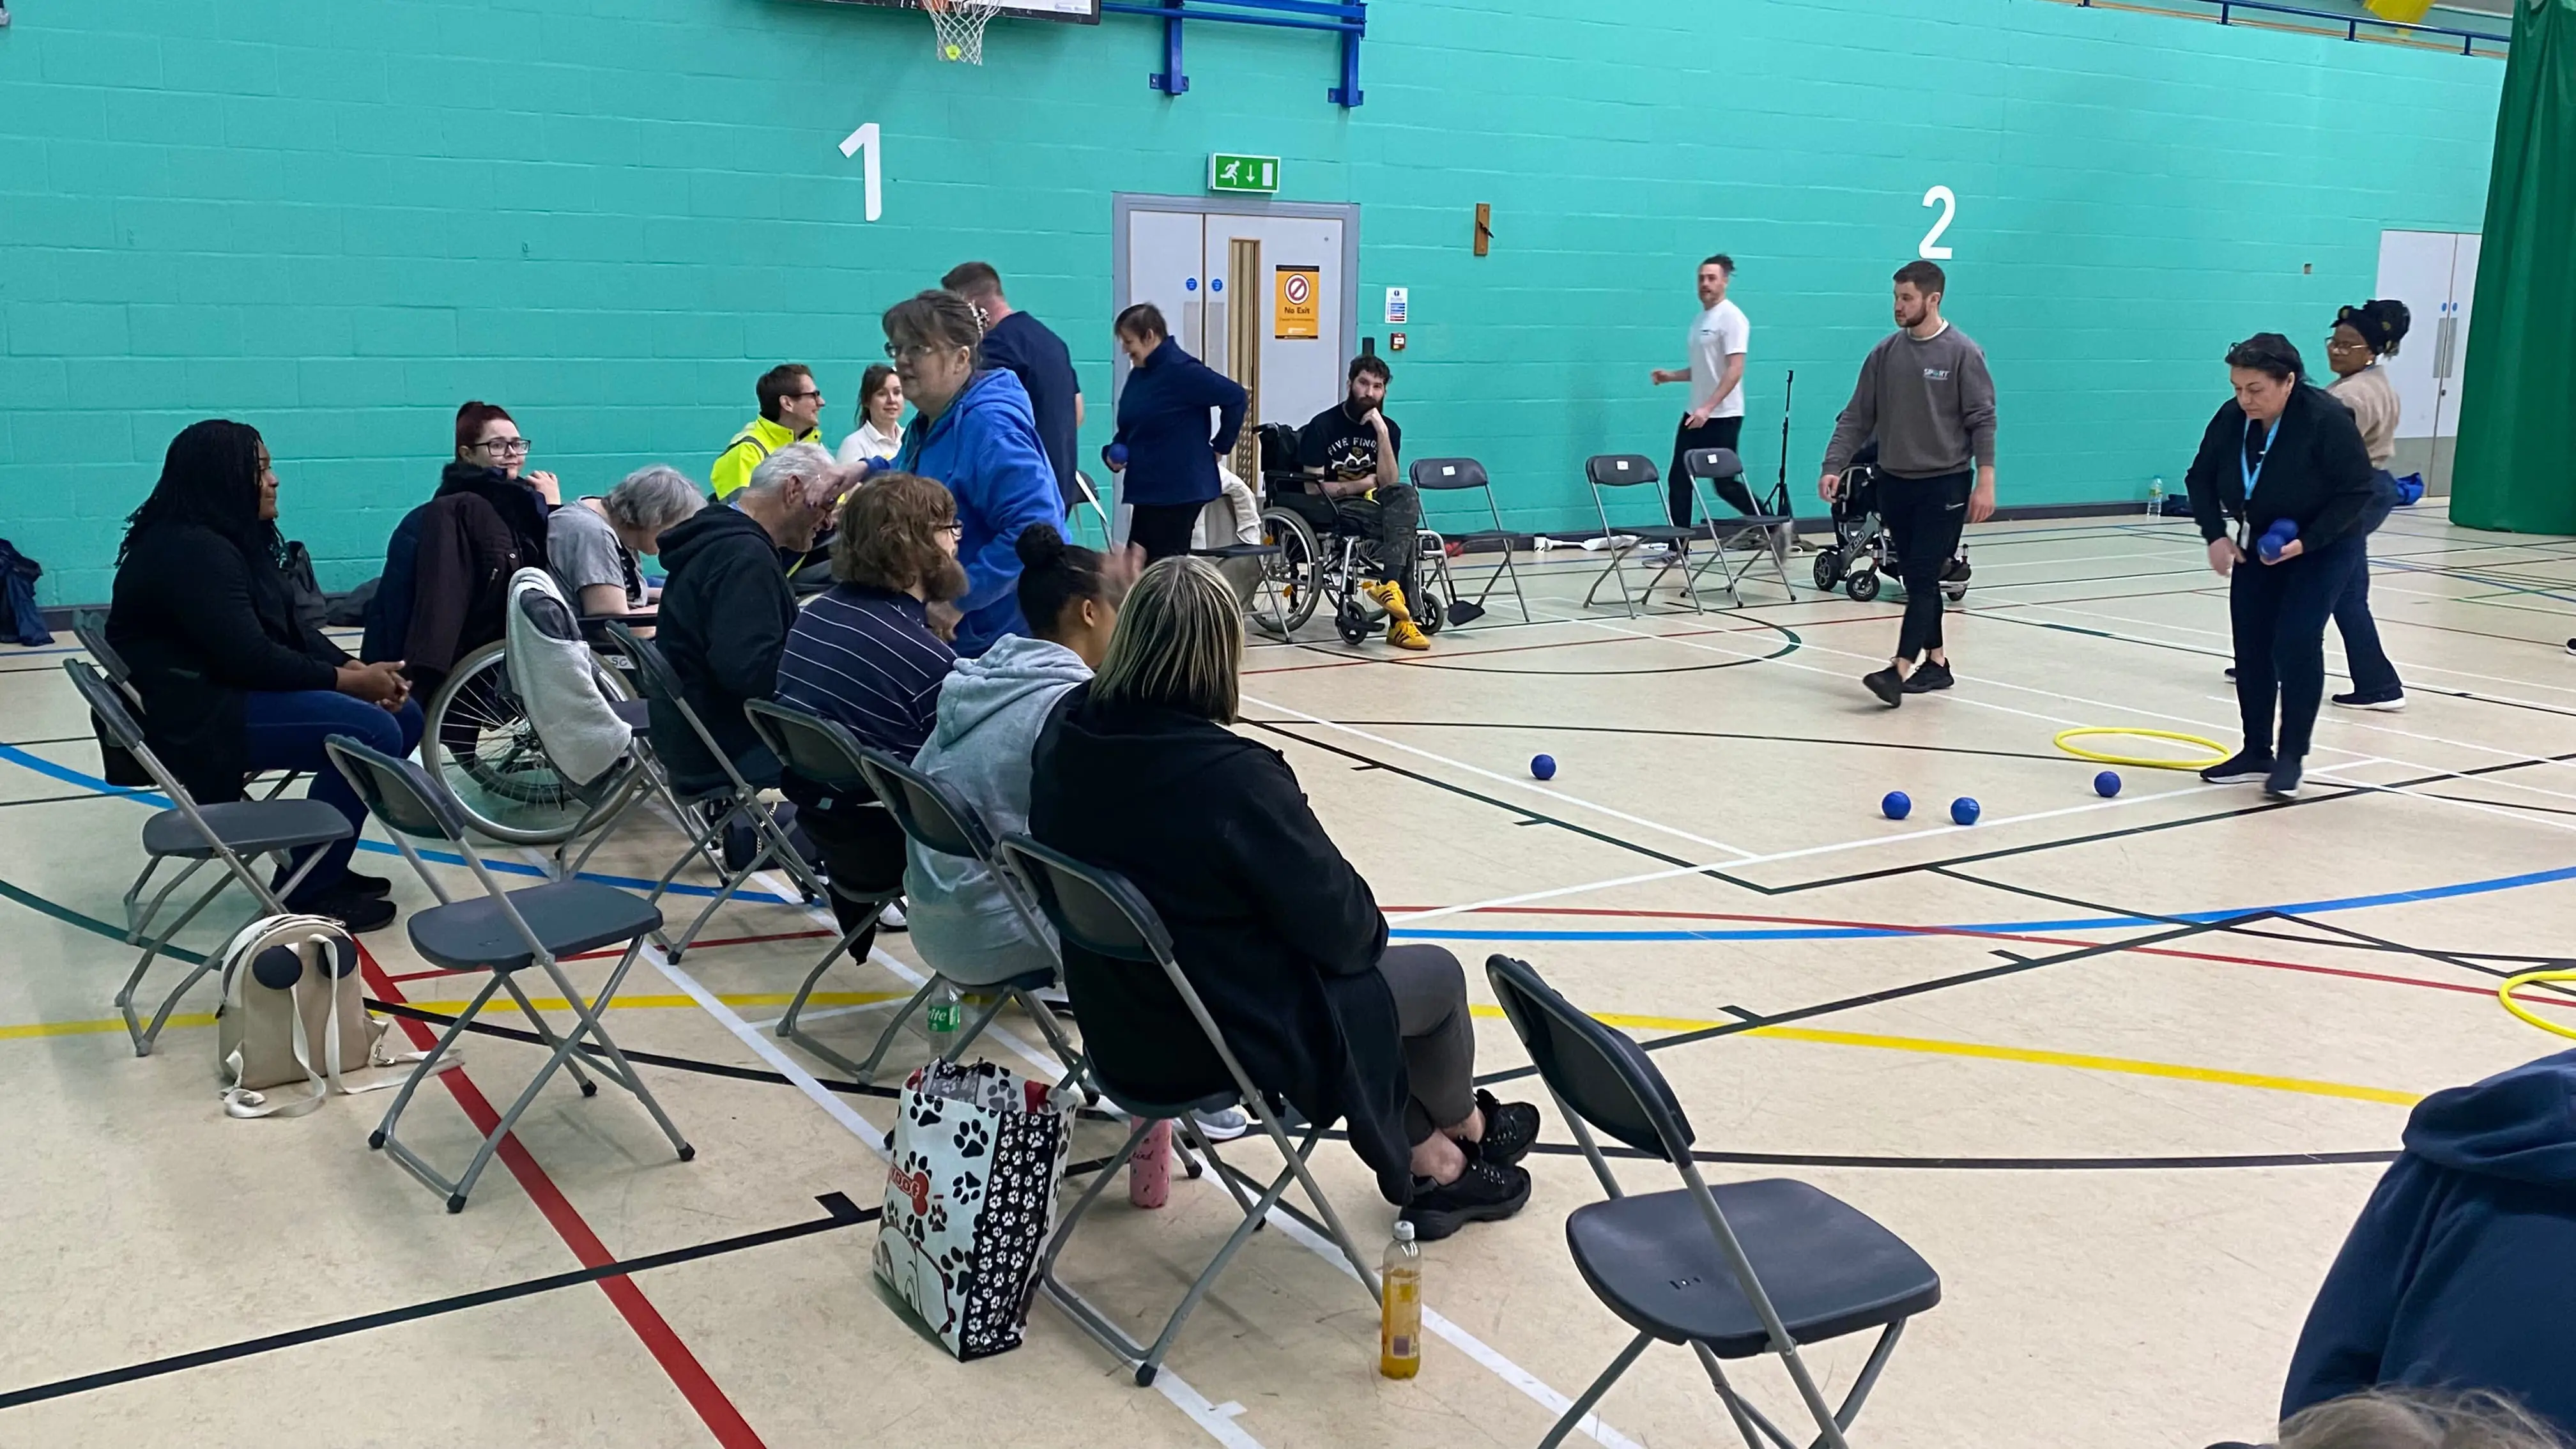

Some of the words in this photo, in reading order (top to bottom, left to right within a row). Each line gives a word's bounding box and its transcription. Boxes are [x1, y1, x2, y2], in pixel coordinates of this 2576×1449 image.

[839, 123, 882, 221] 1
[1919, 185, 1956, 259] 2
[1328, 437, 1349, 456] FIVE
[1353, 437, 1377, 453] FING
